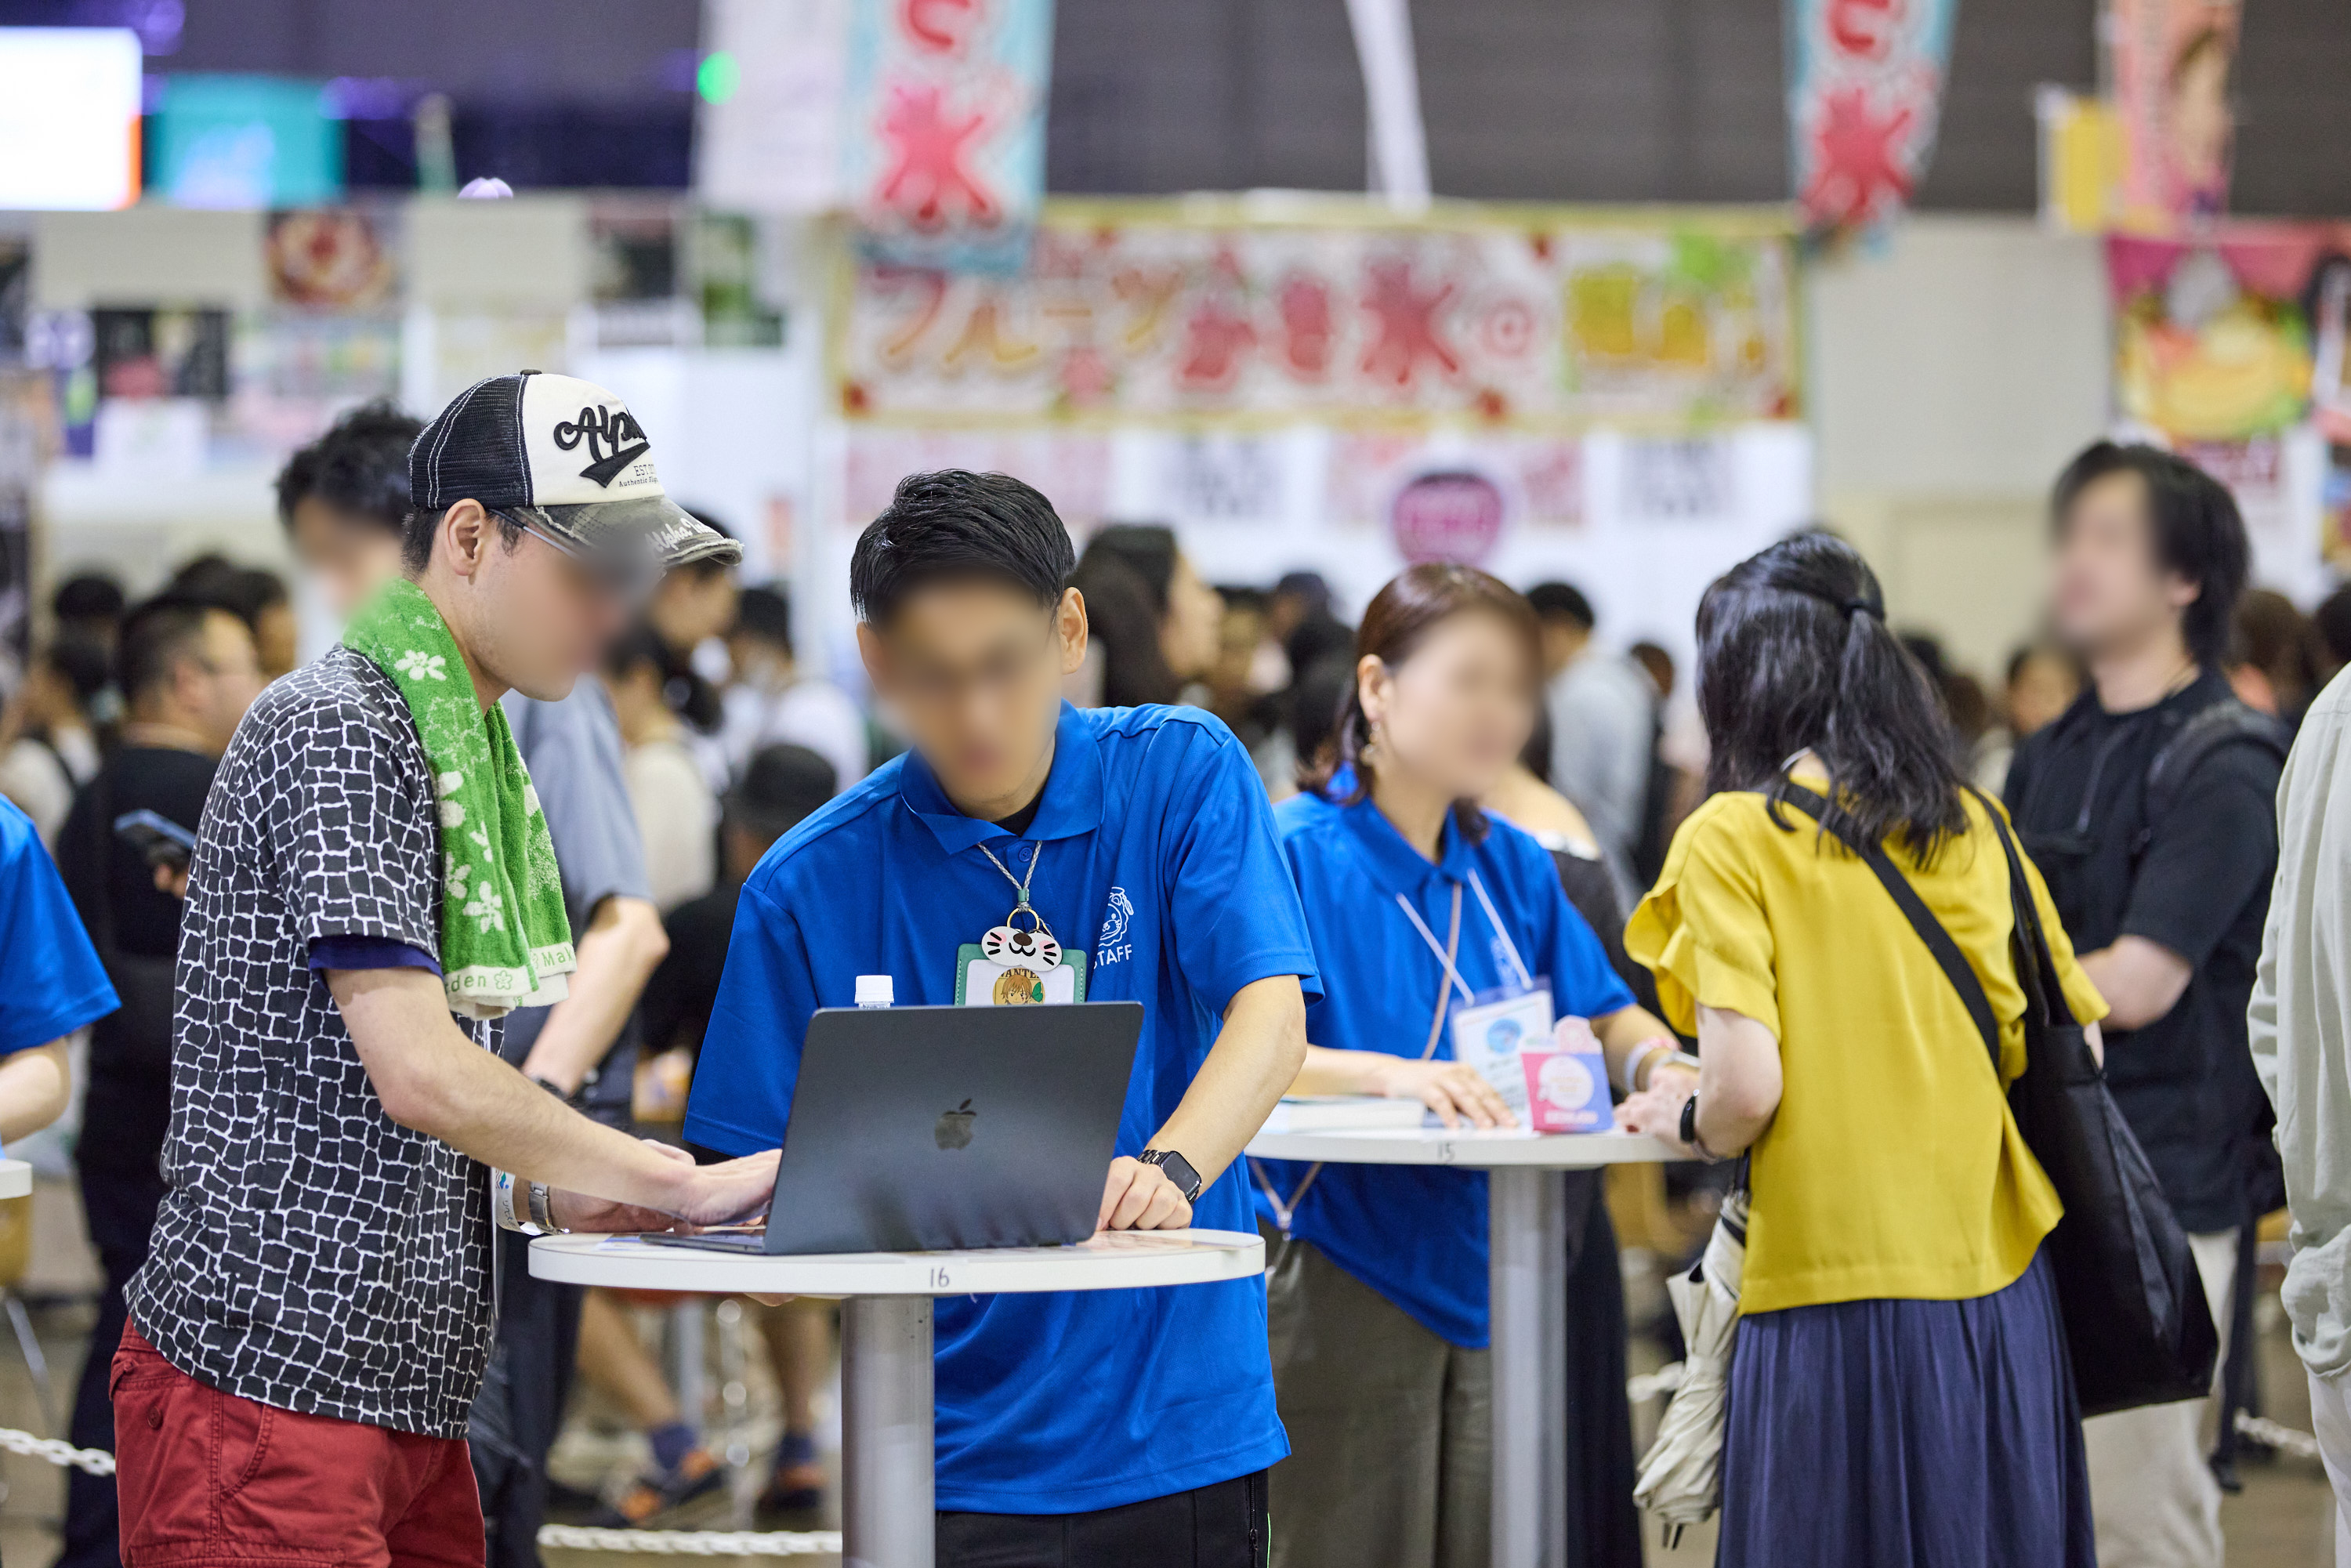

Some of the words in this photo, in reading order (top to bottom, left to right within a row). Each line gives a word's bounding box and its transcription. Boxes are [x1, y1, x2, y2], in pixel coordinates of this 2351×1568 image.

[1093, 943, 1132, 969] TAFF
[1001, 968, 1040, 979] ANTE
[930, 1267, 950, 1288] 16
